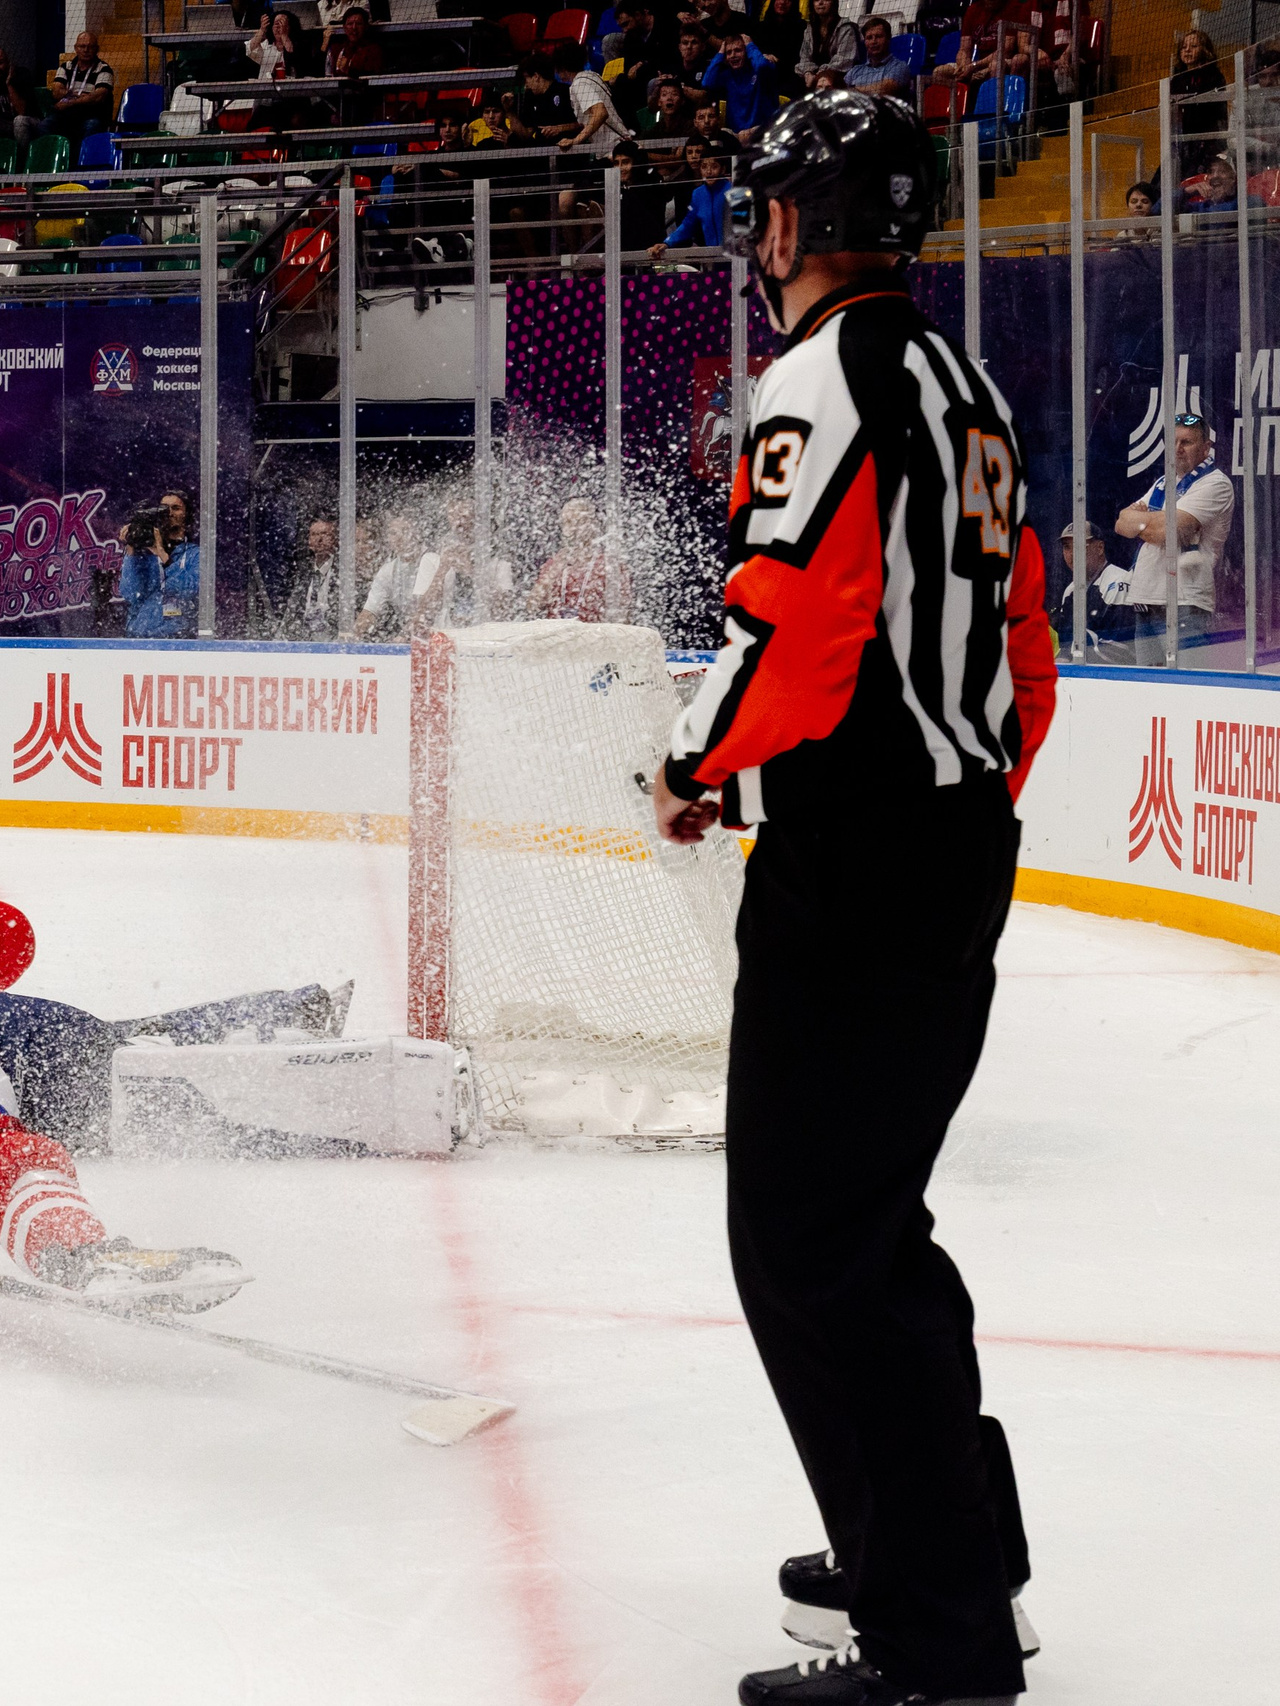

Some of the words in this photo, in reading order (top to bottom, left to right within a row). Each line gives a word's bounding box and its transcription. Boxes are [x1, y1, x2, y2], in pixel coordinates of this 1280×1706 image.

[142, 345, 201, 358] Федерац
[96, 369, 131, 381] ФХМ
[153, 380, 200, 391] Москвы
[156, 364, 198, 374] хоккея
[962, 428, 1013, 558] 43
[123, 667, 378, 735] МОСКОВСКИЙ
[122, 735, 243, 791] СПОРТ
[1193, 802, 1258, 885] СПОРТ
